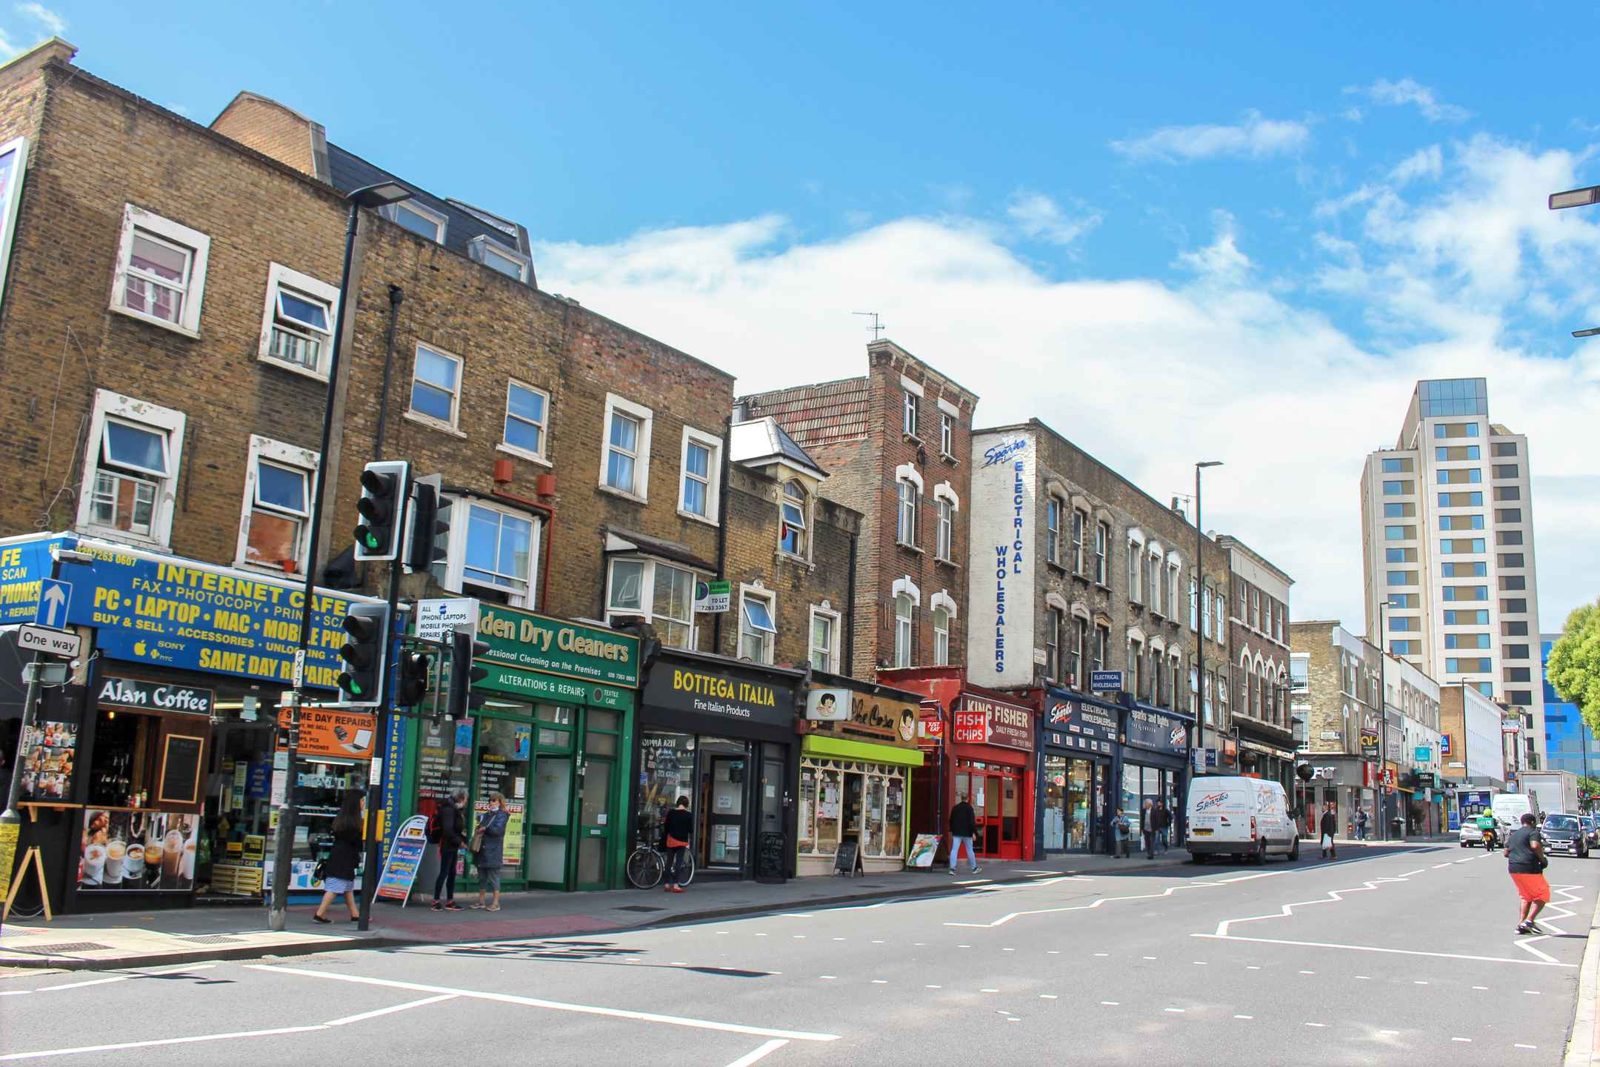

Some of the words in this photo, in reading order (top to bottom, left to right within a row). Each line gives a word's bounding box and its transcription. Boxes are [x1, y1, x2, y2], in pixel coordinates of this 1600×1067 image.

[982, 440, 1026, 466] Sparks
[1014, 462, 1024, 574] ELECTRICAL
[0, 548, 22, 568] FE
[2, 567, 28, 580] SCAN
[157, 562, 284, 604] INTERNET
[289, 590, 348, 617] CAFE
[9, 606, 37, 618] REPAIR
[132, 578, 162, 594] FAX
[175, 587, 262, 613] PHOTOCOPY
[273, 606, 305, 620] PRIN
[323, 615, 344, 628] SCA
[995, 545, 1007, 673] WHOLESALERS
[93, 586, 120, 611] PC
[135, 594, 201, 625] LAPTOP
[213, 609, 251, 634] MAC
[321, 629, 348, 650] PHO
[24, 632, 47, 646] One
[52, 639, 75, 653] way
[93, 612, 121, 625] BUY
[123, 617, 132, 627] &
[136, 619, 165, 633] SELL
[177, 627, 255, 648] ACCESSORIES
[265, 642, 326, 659] UNLOCING
[157, 641, 185, 650] SONY
[477, 608, 516, 640] lden
[519, 619, 554, 652] Dry
[557, 627, 629, 663] Cleaners
[199, 648, 244, 673] SAME
[248, 655, 278, 678] DAY
[485, 651, 518, 661] essional
[519, 653, 549, 668] Cleaning
[561, 661, 572, 671] the
[574, 663, 601, 677] Premises
[98, 680, 147, 705] Alan
[153, 687, 208, 711] Coffee
[498, 674, 548, 691] ALTERATIONS
[550, 682, 555, 692] &
[558, 683, 585, 698] REPAIRS
[673, 669, 735, 700] BOTTEGA
[739, 682, 775, 707] ITALIA
[286, 710, 311, 721] SME
[315, 713, 332, 723] DAY
[335, 716, 372, 727] REPAIRS
[694, 699, 707, 710] Fine
[707, 700, 725, 713] Italian
[726, 705, 750, 718] Products
[956, 714, 984, 726] FISH
[995, 706, 1028, 728] FISHER
[1081, 702, 1108, 717] ELECTRICAL
[956, 729, 983, 741] CHIPS
[504, 803, 522, 813] FFER
[1196, 793, 1229, 812] Sparks
